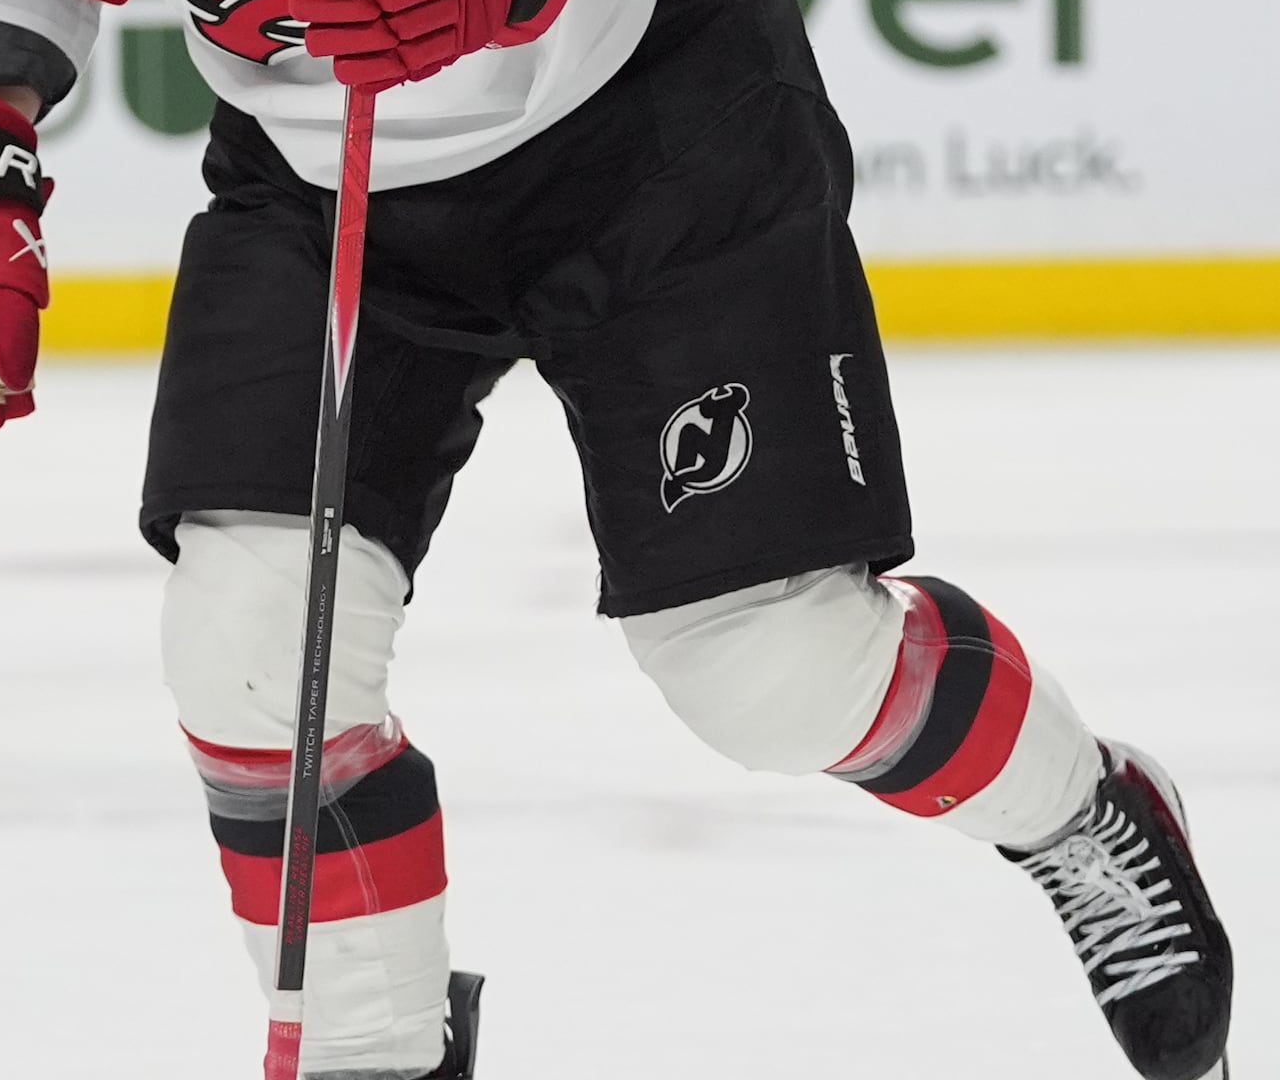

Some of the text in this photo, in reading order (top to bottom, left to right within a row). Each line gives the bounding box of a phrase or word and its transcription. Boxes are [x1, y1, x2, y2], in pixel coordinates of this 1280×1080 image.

[303, 584, 327, 778] TWITCH TAPER TECHNOLOGY
